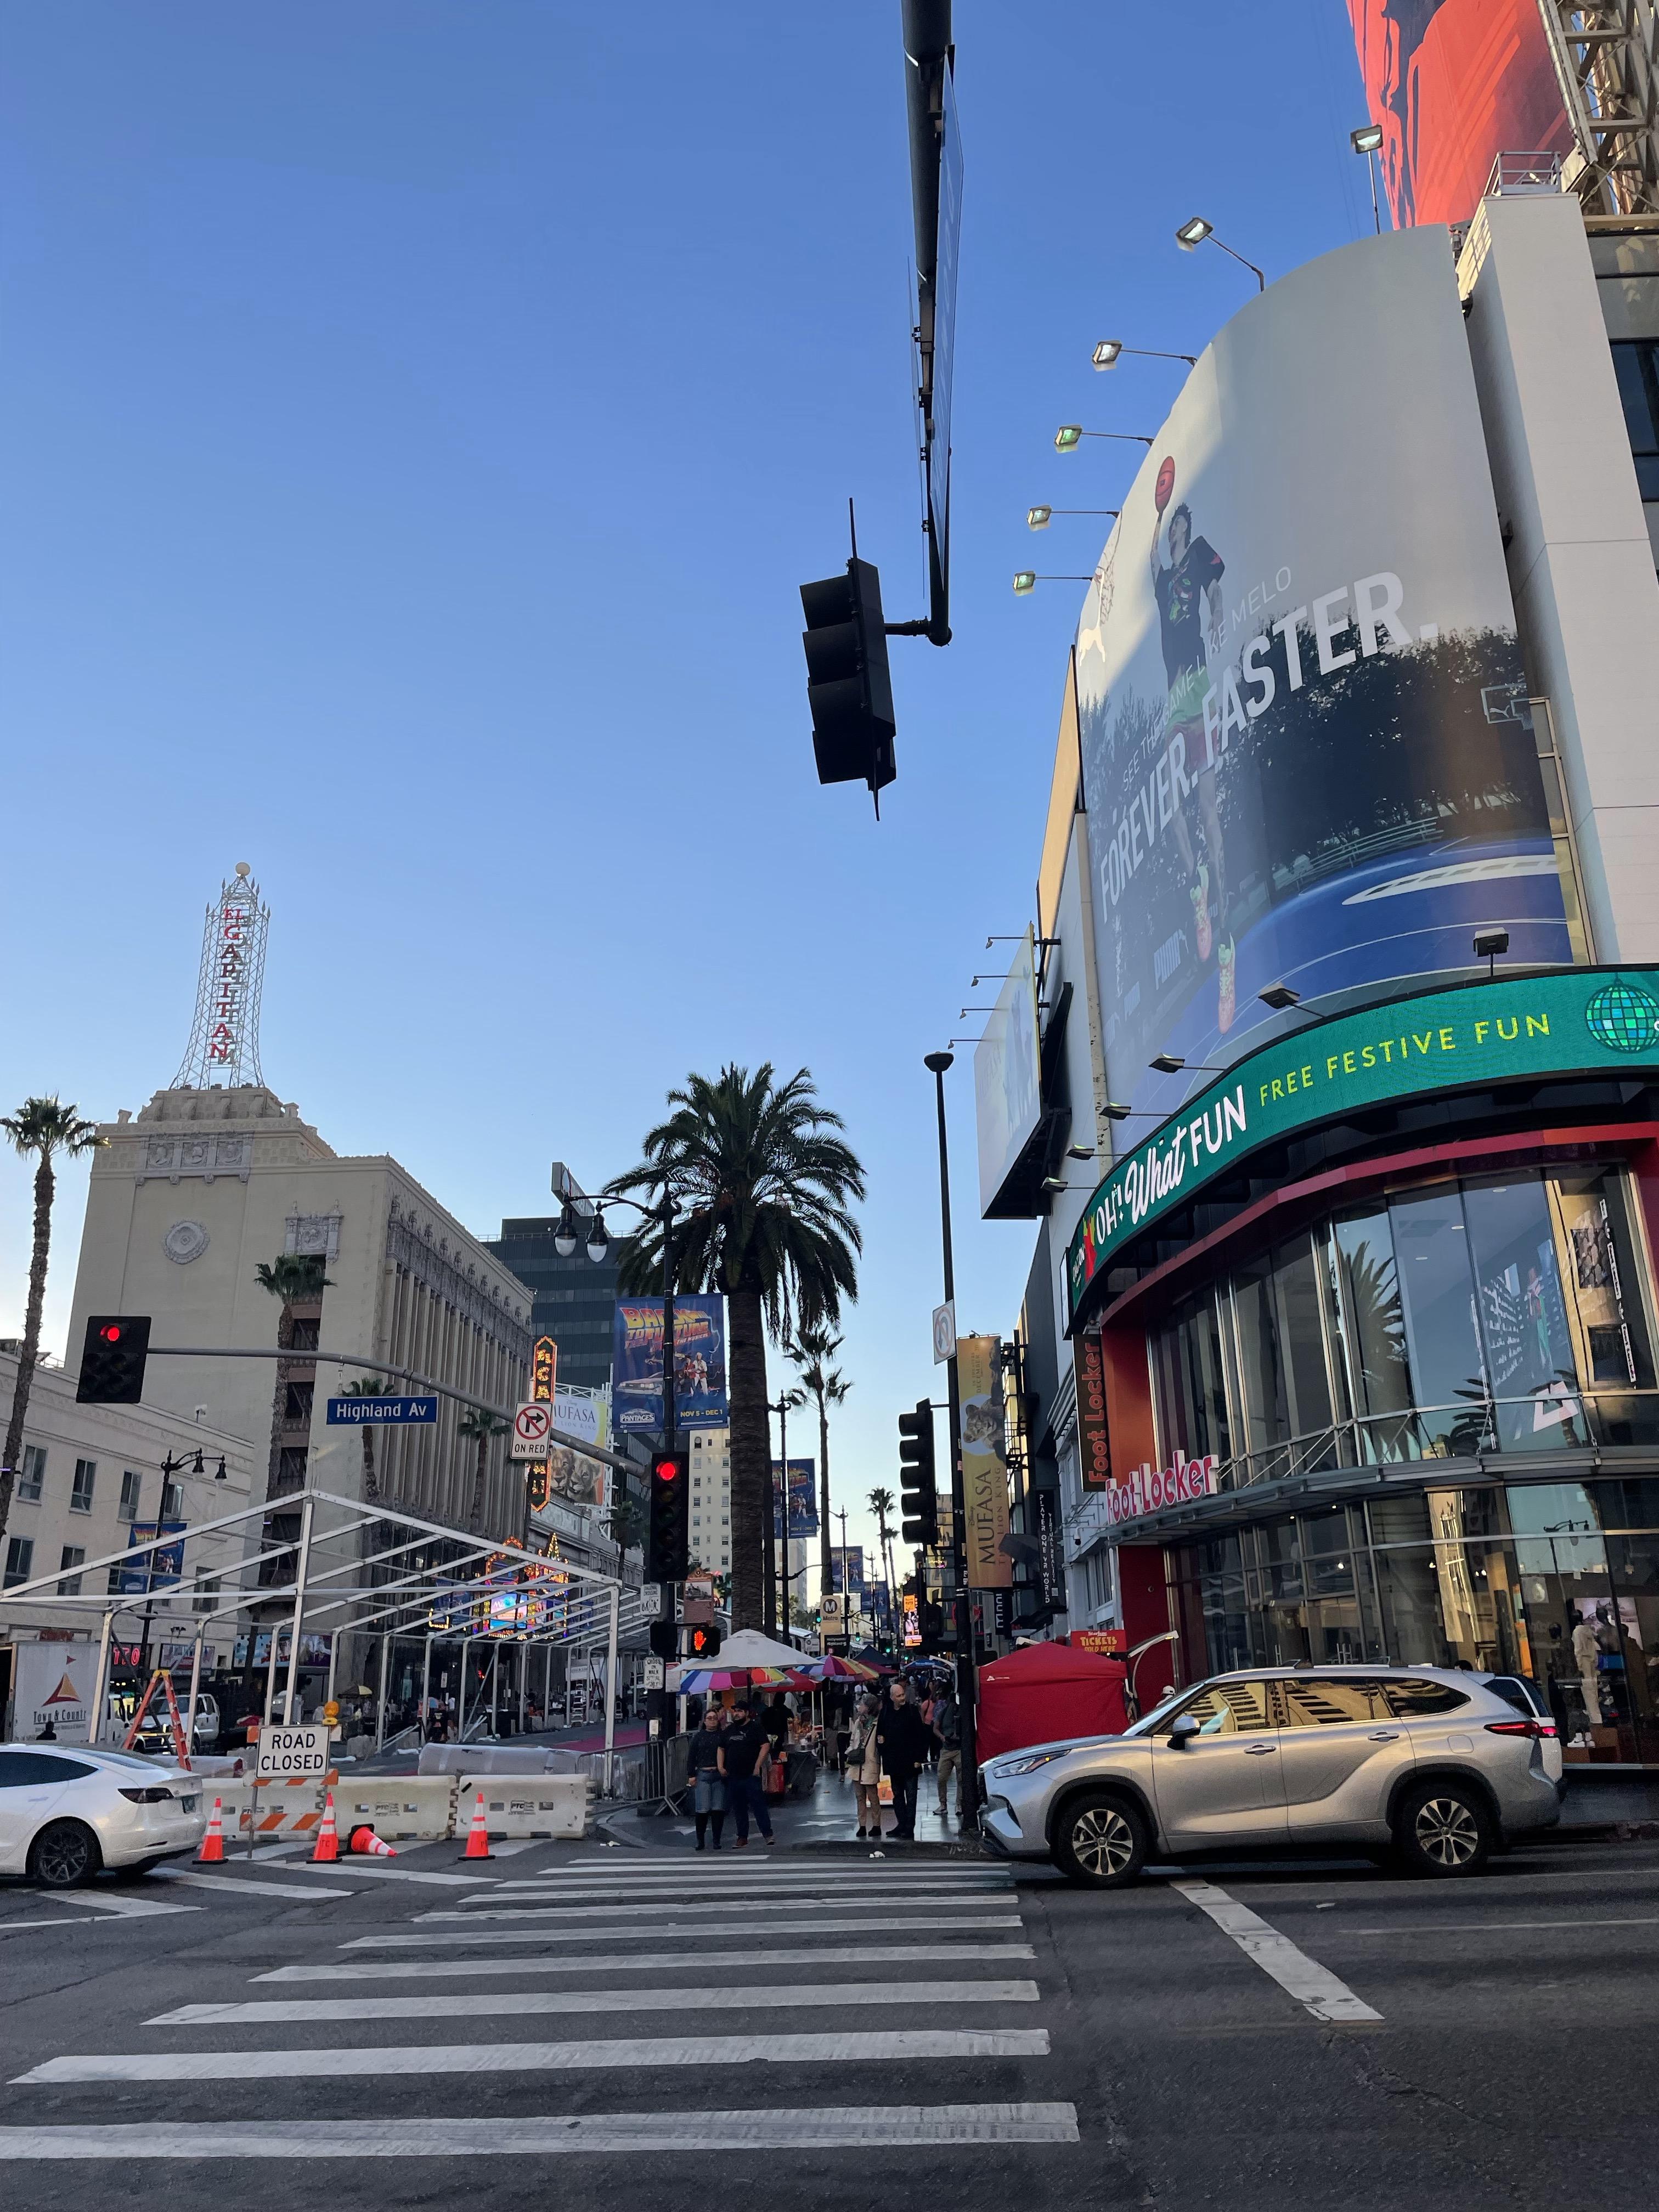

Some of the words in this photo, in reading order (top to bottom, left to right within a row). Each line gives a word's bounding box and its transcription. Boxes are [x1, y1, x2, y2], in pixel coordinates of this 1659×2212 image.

[1122, 754, 1141, 792] SEE
[1141, 720, 1164, 759] THE
[1163, 670, 1195, 727] GAME
[1231, 566, 1293, 632] MELO
[1100, 732, 1199, 924] FOREVER.
[1201, 571, 1438, 767] FASTER.
[210, 924, 240, 1059] CAPITAN
[1096, 1184, 1124, 1245] OH!
[1125, 1125, 1187, 1225] What
[1190, 1085, 1247, 1167] FUN
[1260, 1065, 1314, 1107] FREE
[1326, 1028, 1456, 1080] FESTIVE
[1474, 1013, 1550, 1044] FUN
[627, 1330, 642, 1341] TO
[688, 1333, 709, 1343] MUSICAL
[1081, 1342, 1104, 1421] Locker
[336, 1403, 401, 1422] Highland
[409, 1402, 427, 1417] Av
[620, 1414, 655, 1422] PANTAGES
[515, 1443, 526, 1453] ON
[529, 1444, 545, 1453] RED
[1088, 1429, 1109, 1482] Foot
[1105, 1471, 1142, 1525] Foot
[1139, 1450, 1219, 1514] Locker
[975, 1468, 996, 1565] MUFASA
[1043, 1556, 1048, 1569] VR
[825, 1601, 836, 1612] M
[1080, 1637, 1118, 1646] TICKETS
[33, 1711, 52, 1724] Town
[54, 1709, 59, 1720] &
[272, 1734, 315, 1749] ROAD
[261, 1754, 323, 1770] CLOSED
